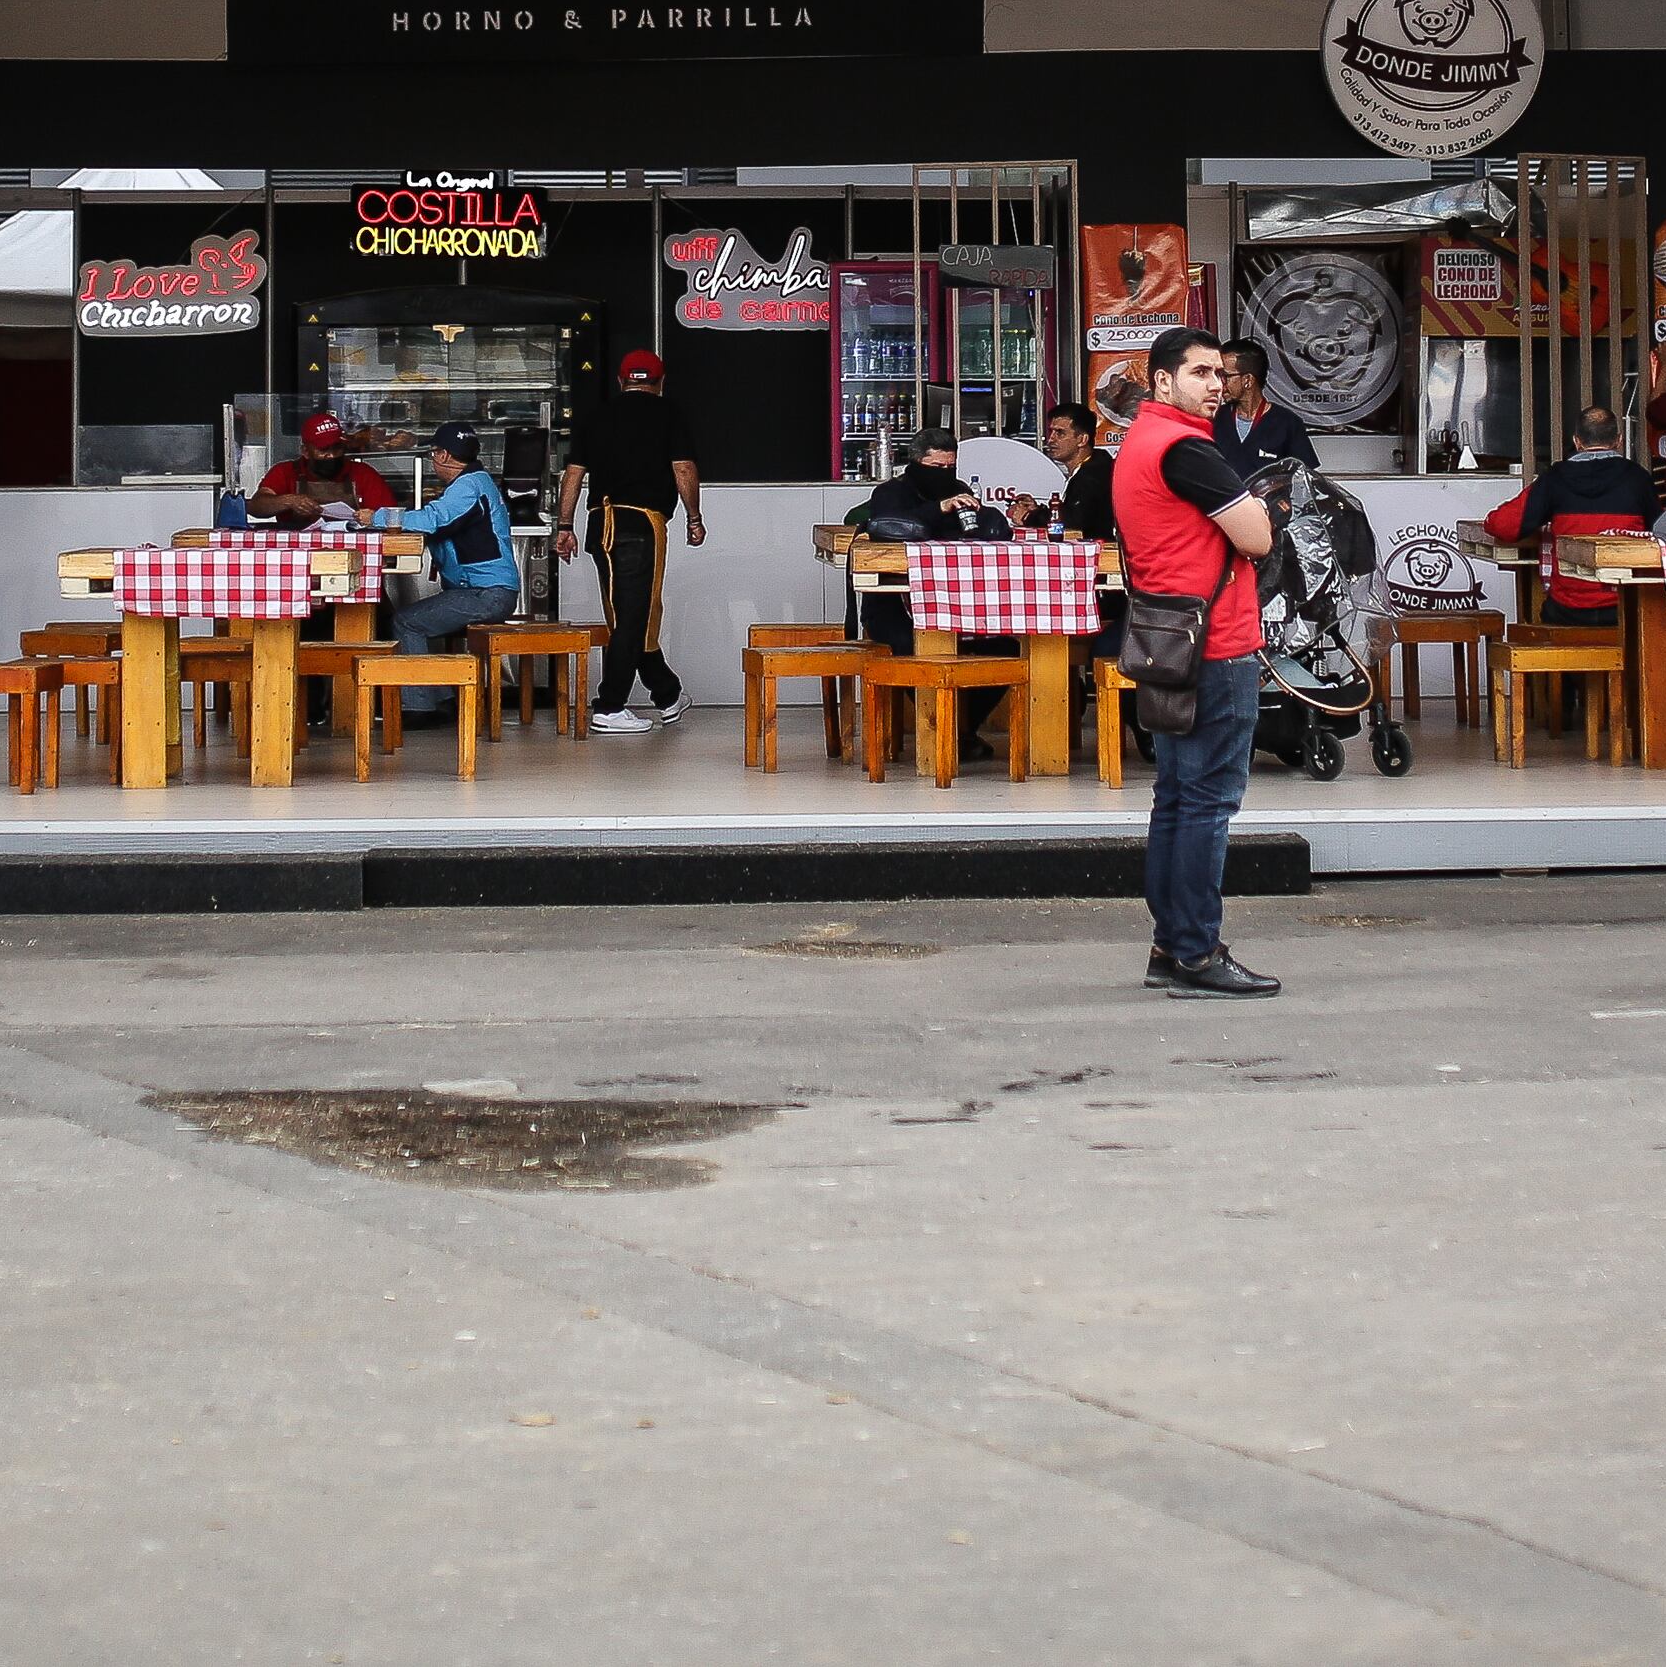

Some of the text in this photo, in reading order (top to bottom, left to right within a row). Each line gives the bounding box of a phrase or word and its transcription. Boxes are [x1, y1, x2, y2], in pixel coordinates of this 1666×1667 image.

[393, 5, 814, 32] HORNO & PARRILLA
[1355, 46, 1510, 83] DONDE JIMMY
[1340, 67, 1513, 132] Calidad Y Sabor Para Toda Ocasión
[1353, 112, 1372, 132] 313
[1370, 128, 1390, 144] 412
[1389, 138, 1417, 154] 3497
[1426, 145, 1445, 155] 313
[1447, 142, 1468, 154] 832
[1468, 128, 1494, 149] 2602
[357, 190, 541, 226] COSTILLA
[356, 226, 540, 258] CHICHARRONADA
[942, 246, 993, 266] CAJA
[1437, 253, 1495, 266] DELICIOSO
[695, 234, 829, 300] chimba
[989, 269, 1048, 285] RAPIDA
[1437, 268, 1495, 281] CONO DE
[82, 268, 200, 301] I Love
[1436, 284, 1497, 299] LECHONA
[80, 299, 253, 329] Chicharron
[685, 297, 723, 320] de
[1093, 313, 1180, 325] Cono de Lechona
[1091, 332, 1101, 347] $
[1657, 324, 1666, 338] $
[1293, 394, 1330, 402] DESDE
[986, 487, 1016, 502] LOS
[1432, 596, 1474, 610] JIMMY
